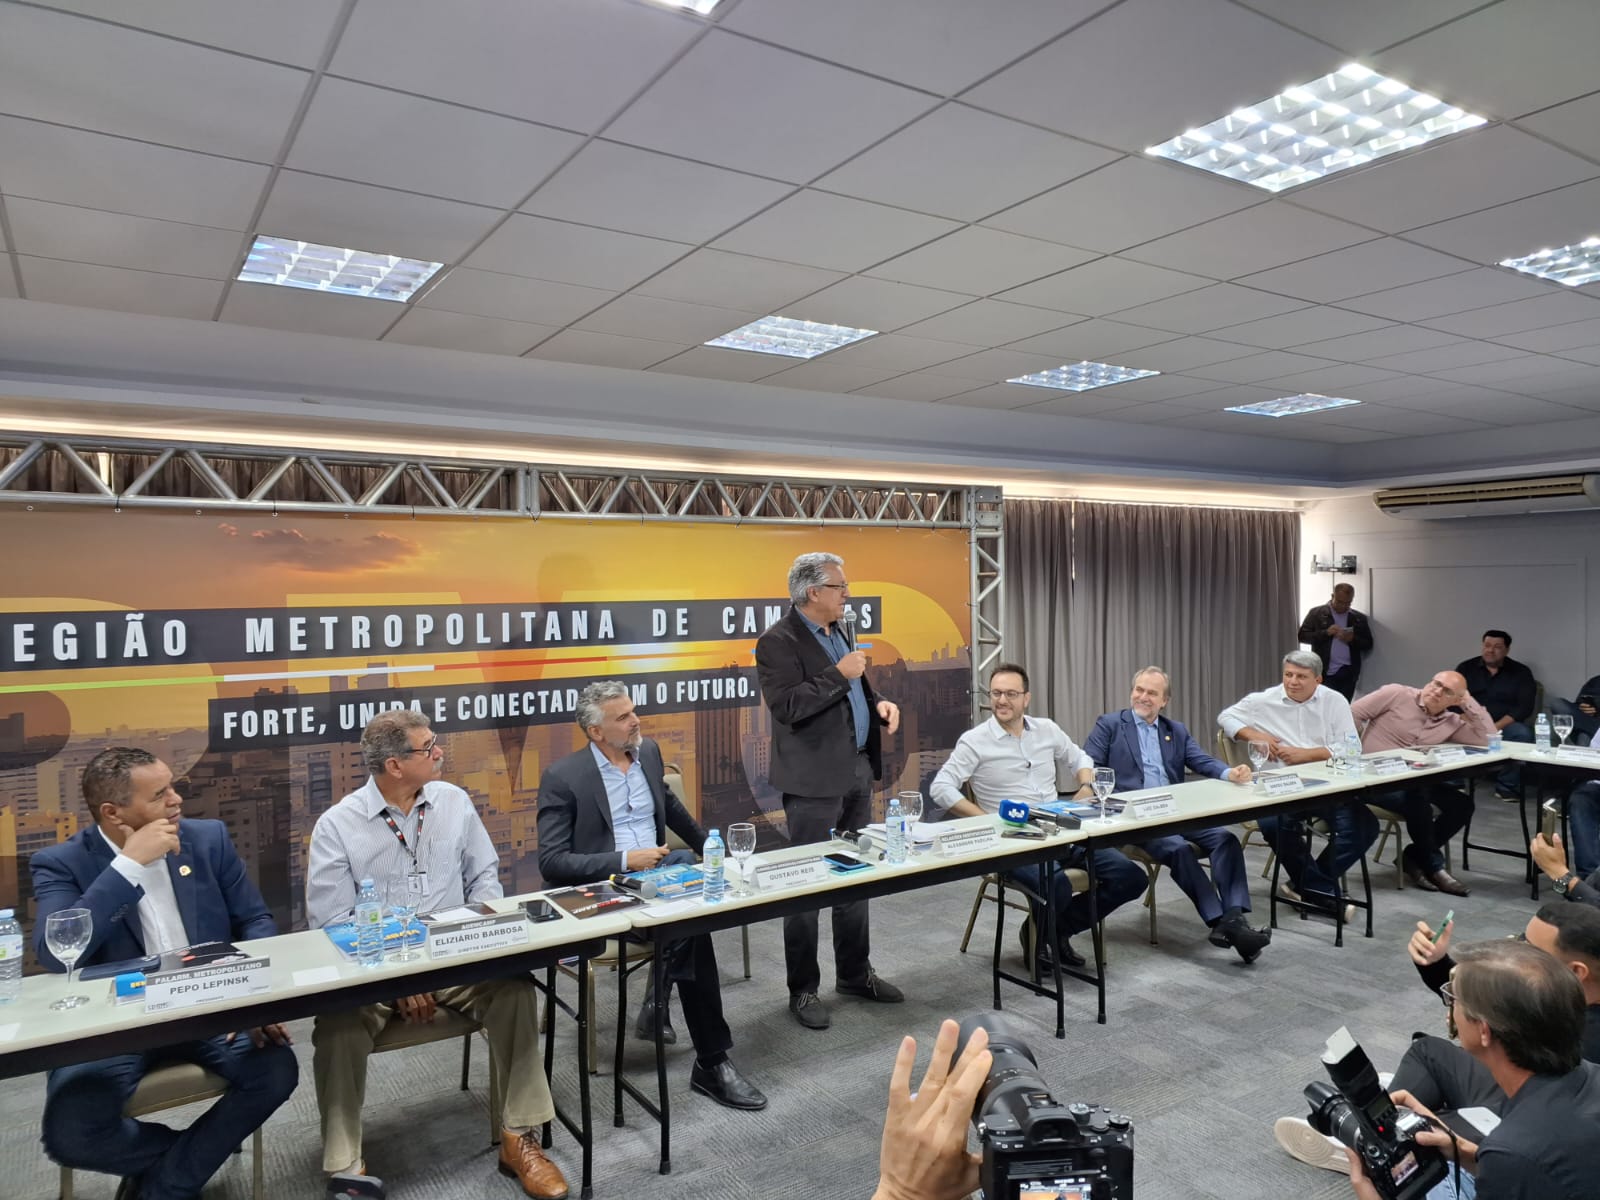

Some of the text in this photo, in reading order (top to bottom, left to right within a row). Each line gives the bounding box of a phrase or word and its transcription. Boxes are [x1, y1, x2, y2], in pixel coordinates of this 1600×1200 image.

[245, 609, 615, 653] METROPOLITANA
[652, 607, 689, 637] DE
[223, 705, 327, 739] FORTE,
[434, 697, 447, 722] E
[457, 689, 579, 721] CONECTAD
[656, 682, 668, 704] O
[676, 676, 755, 703] FUTURO.
[769, 870, 799, 881] GUSTAVO
[801, 867, 814, 875] REIS
[482, 925, 523, 939] BARBOSA
[170, 983, 200, 995] PEPO
[203, 975, 249, 990] LEPINSK
